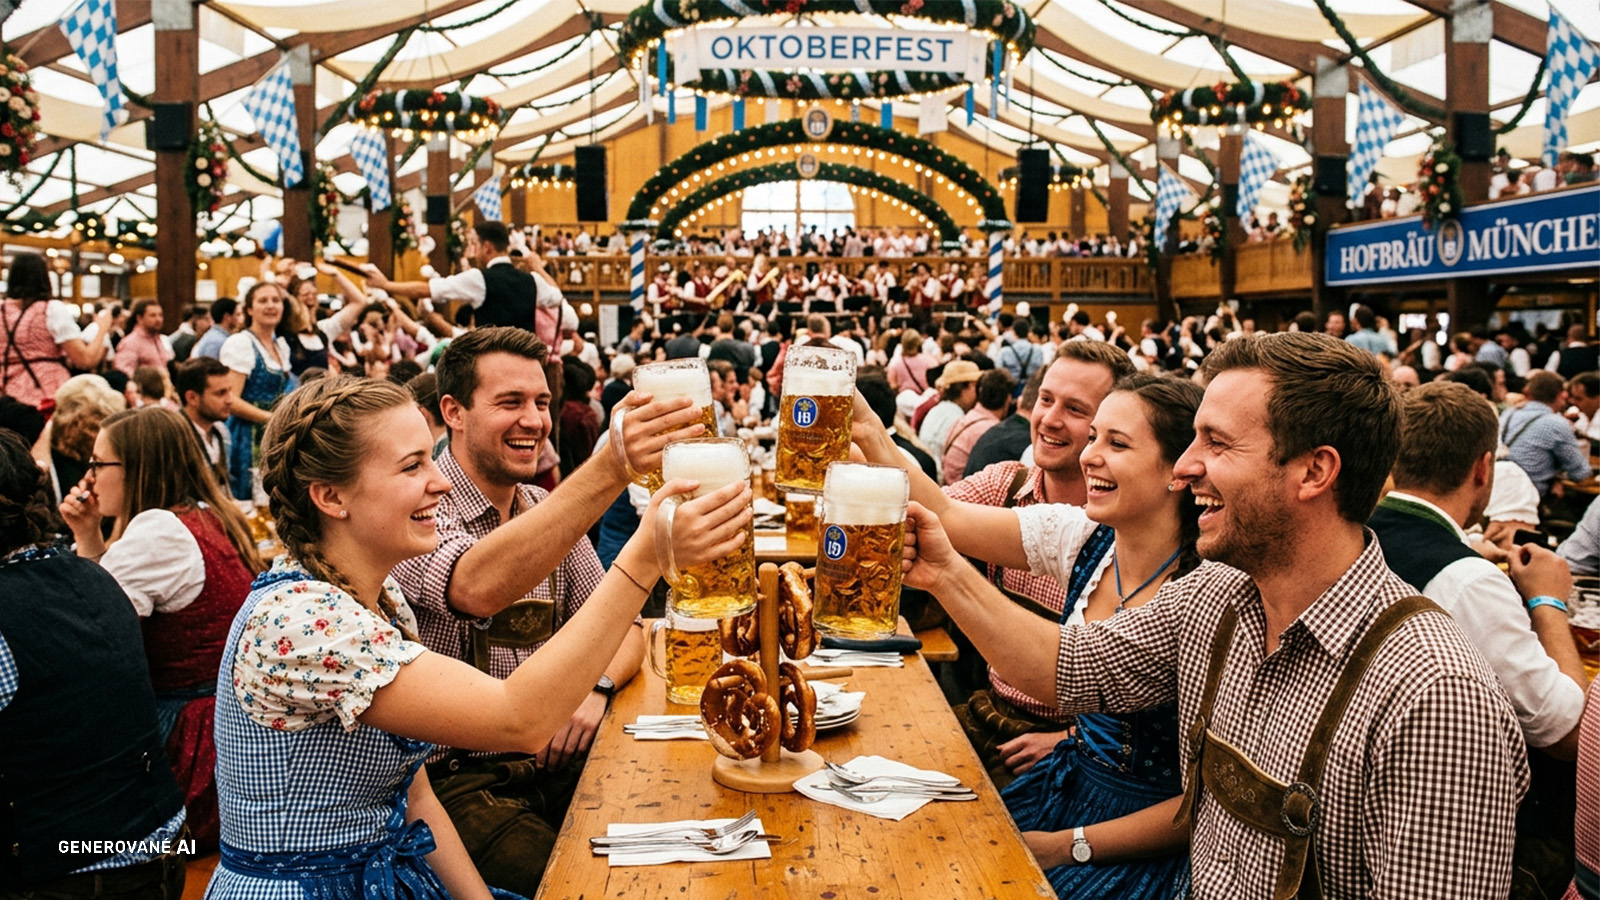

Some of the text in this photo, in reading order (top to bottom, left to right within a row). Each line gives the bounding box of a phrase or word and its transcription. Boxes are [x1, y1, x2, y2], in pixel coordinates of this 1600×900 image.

[711, 35, 953, 62] OKTOBERFEST
[1340, 213, 1600, 274] HOFBRÄU MÜNCHE
